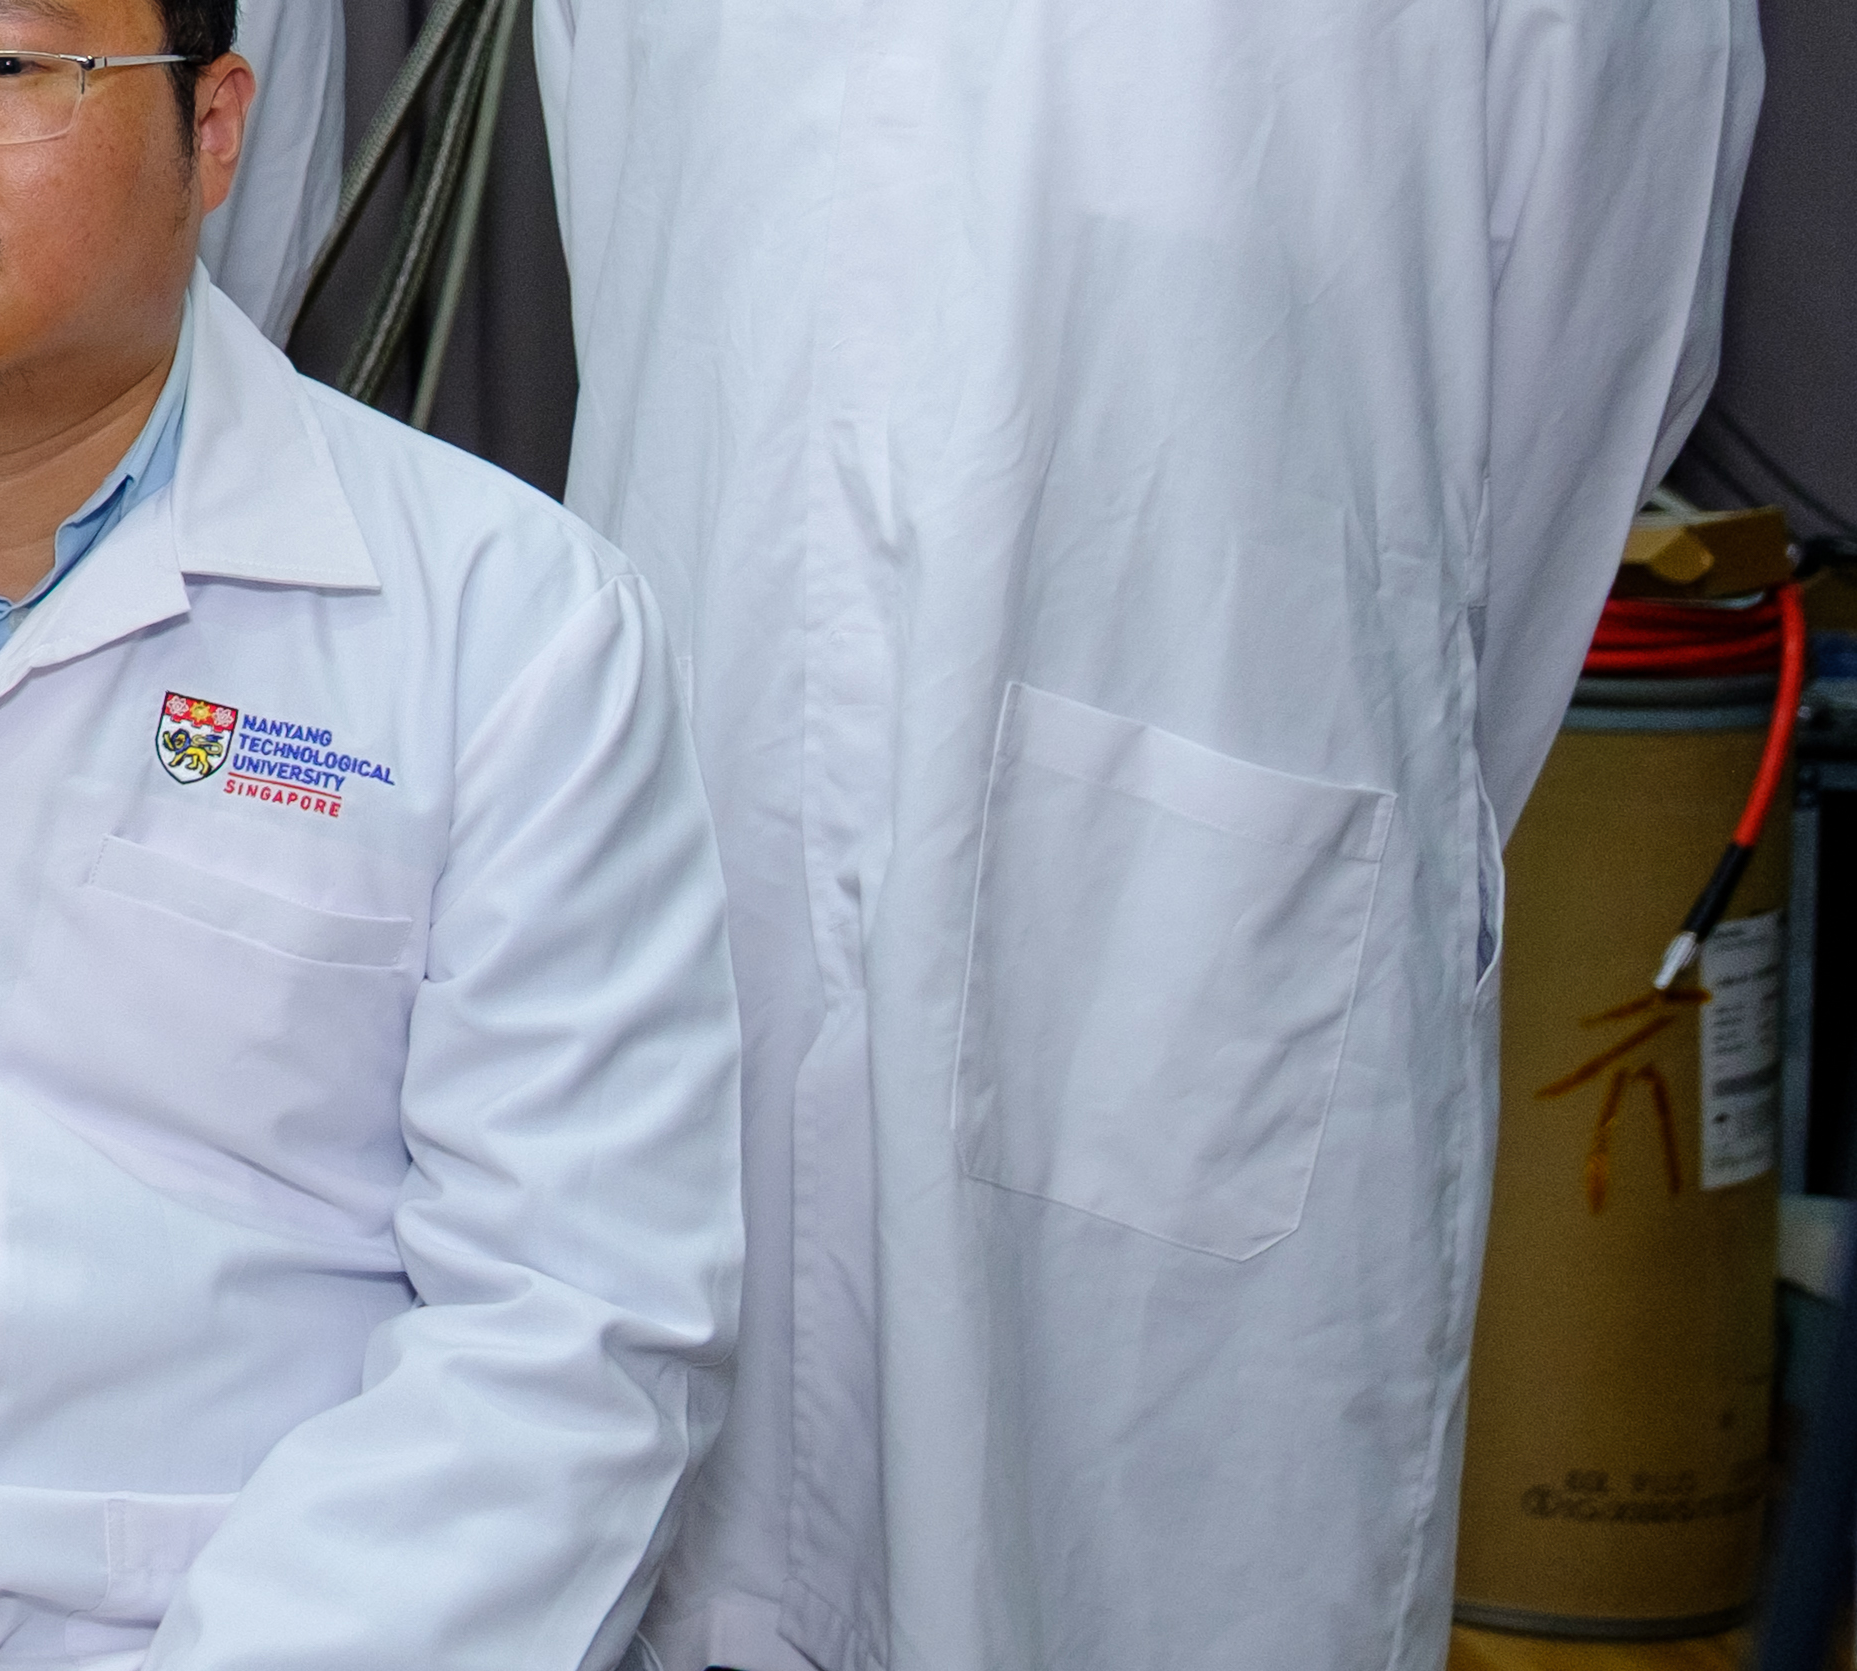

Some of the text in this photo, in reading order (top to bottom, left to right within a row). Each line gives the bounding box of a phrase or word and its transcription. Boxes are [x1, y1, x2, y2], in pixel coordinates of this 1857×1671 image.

[242, 714, 333, 747] NANYANG
[232, 753, 346, 791] UNIVERSITY
[239, 733, 395, 786] TECHNOLOGICAL
[224, 778, 342, 817] SINGAPORE
